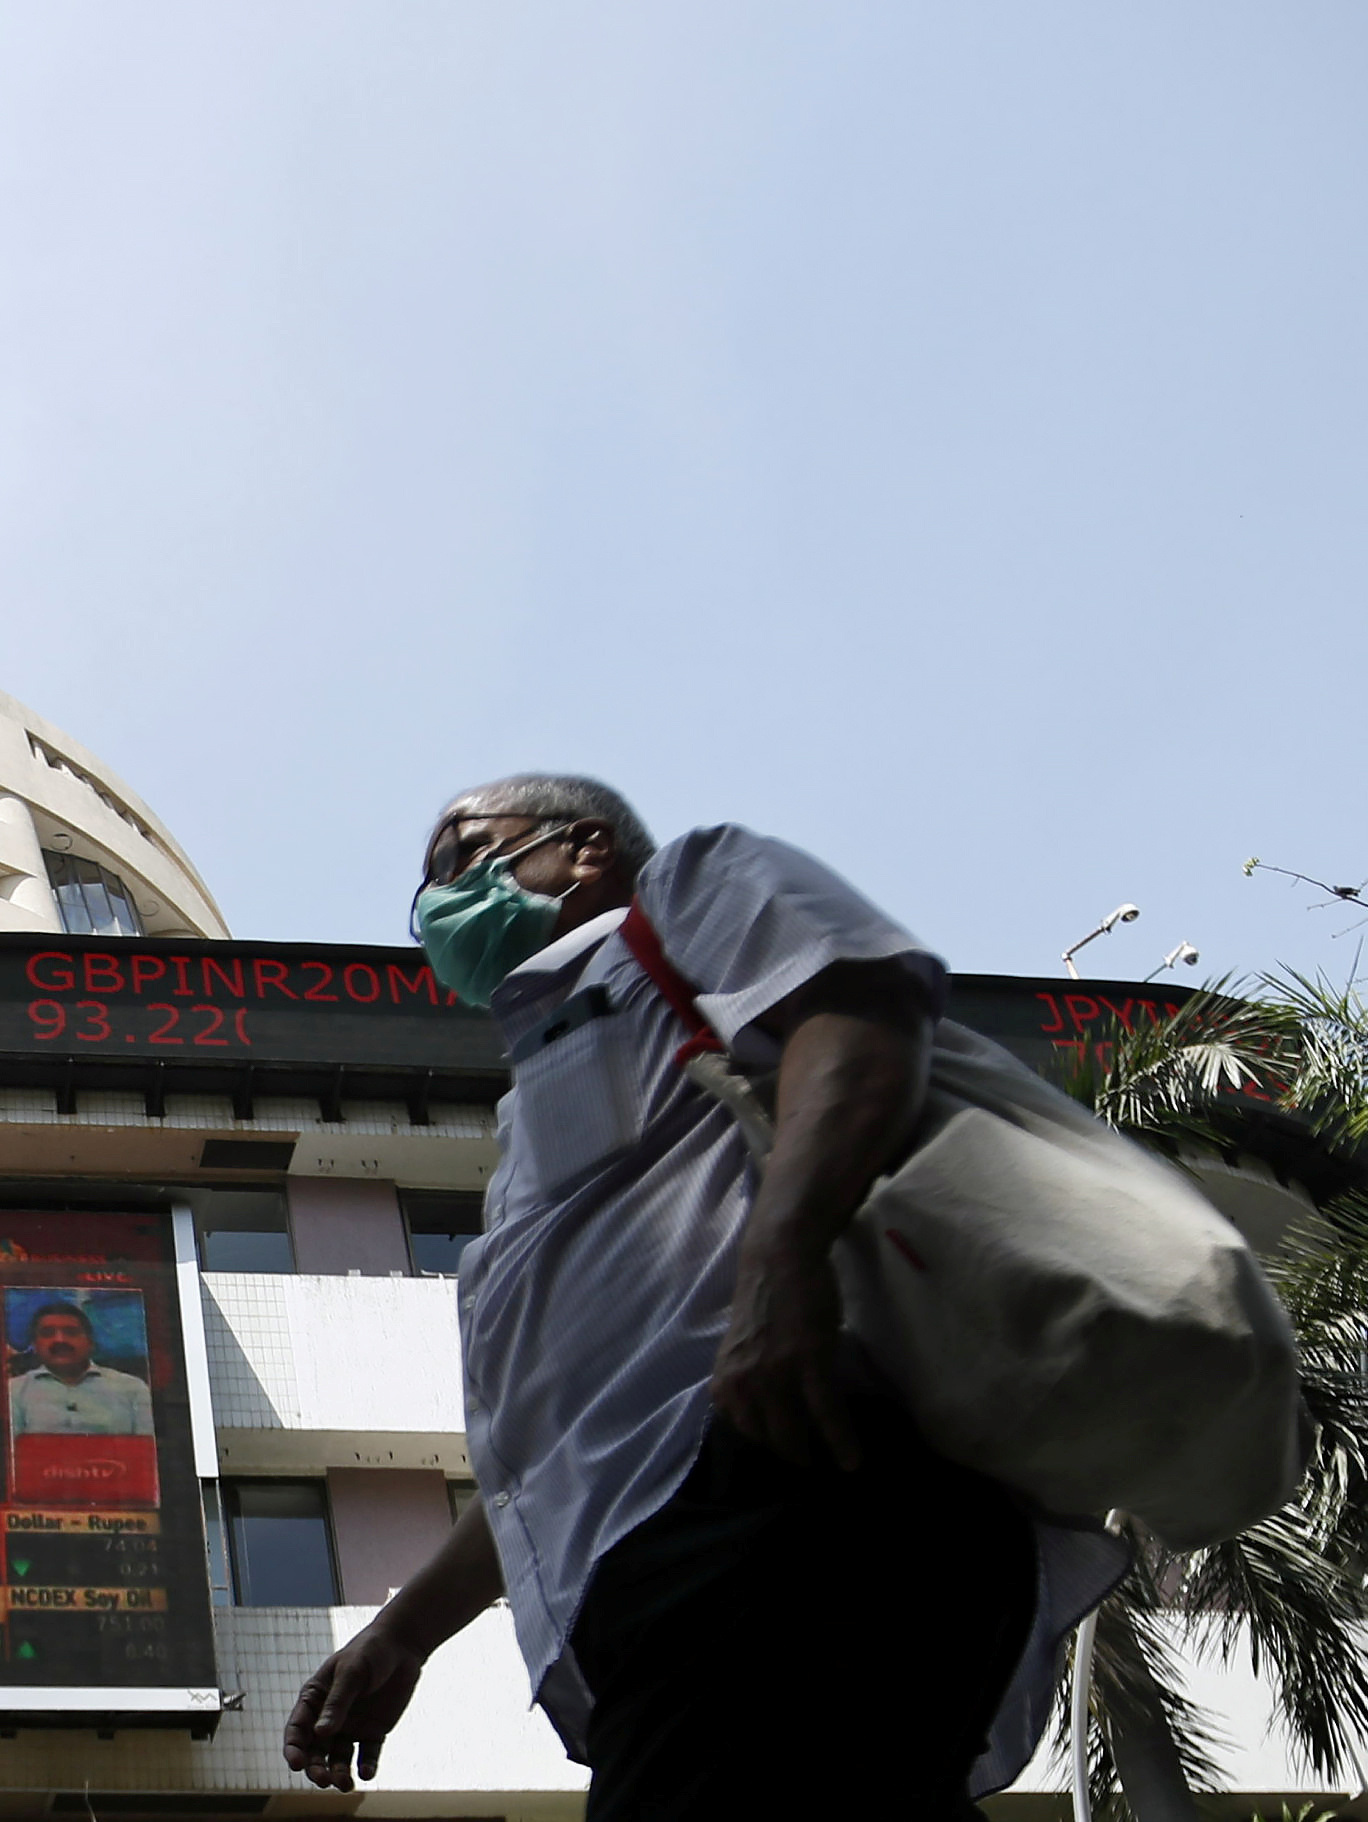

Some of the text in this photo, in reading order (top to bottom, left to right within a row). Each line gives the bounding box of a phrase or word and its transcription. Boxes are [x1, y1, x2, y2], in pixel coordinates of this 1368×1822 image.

[26, 952, 458, 1006] GBPINR20M
[8, 1513, 64, 1531] Dollar
[88, 1515, 147, 1534] Rupee
